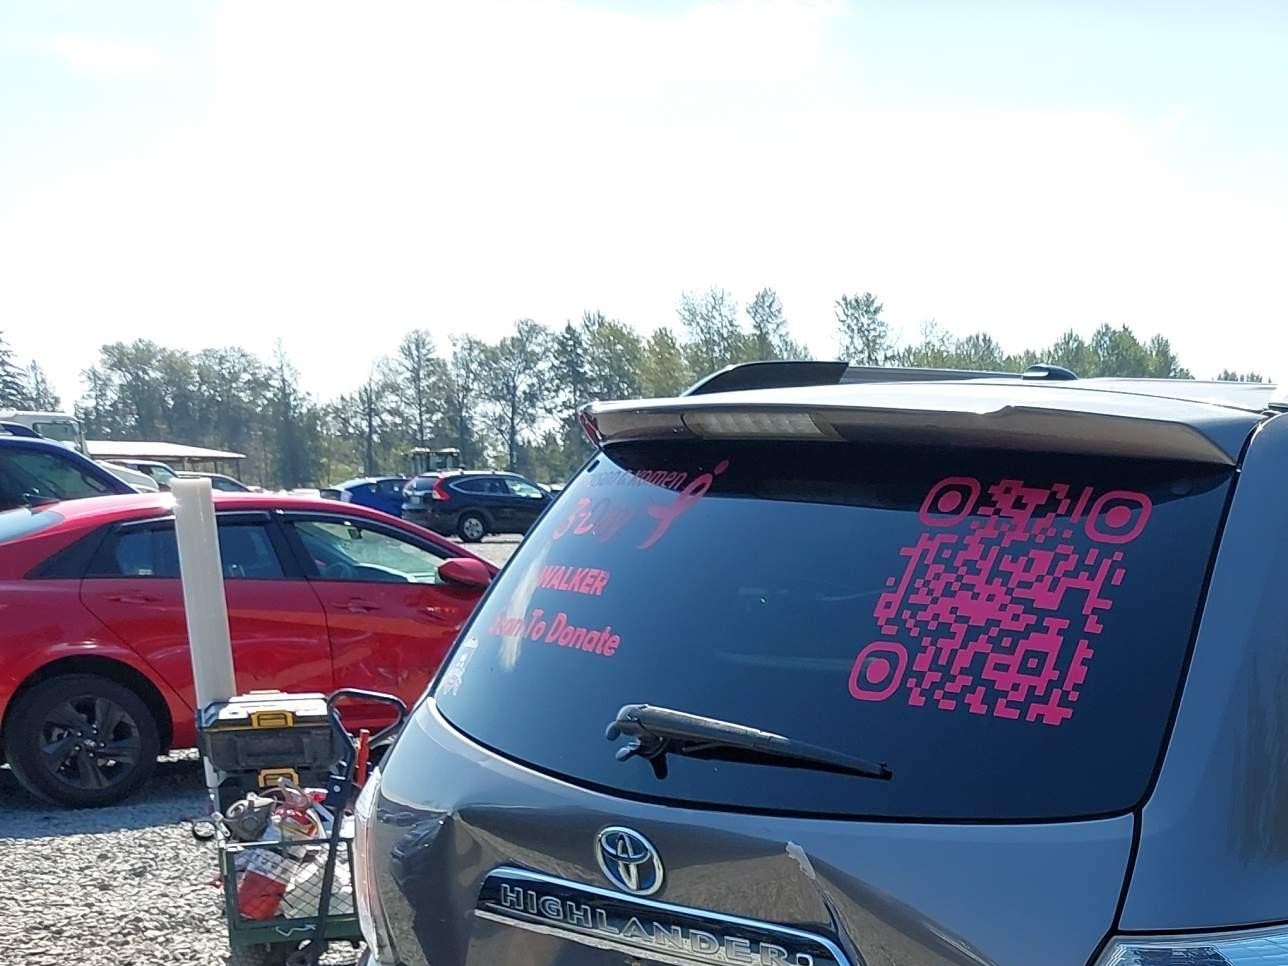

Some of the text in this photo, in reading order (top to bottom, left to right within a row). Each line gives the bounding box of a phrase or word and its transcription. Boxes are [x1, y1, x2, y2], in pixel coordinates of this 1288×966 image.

[540, 565, 609, 596] WALKER
[526, 608, 547, 641] To
[545, 612, 621, 657] Donate
